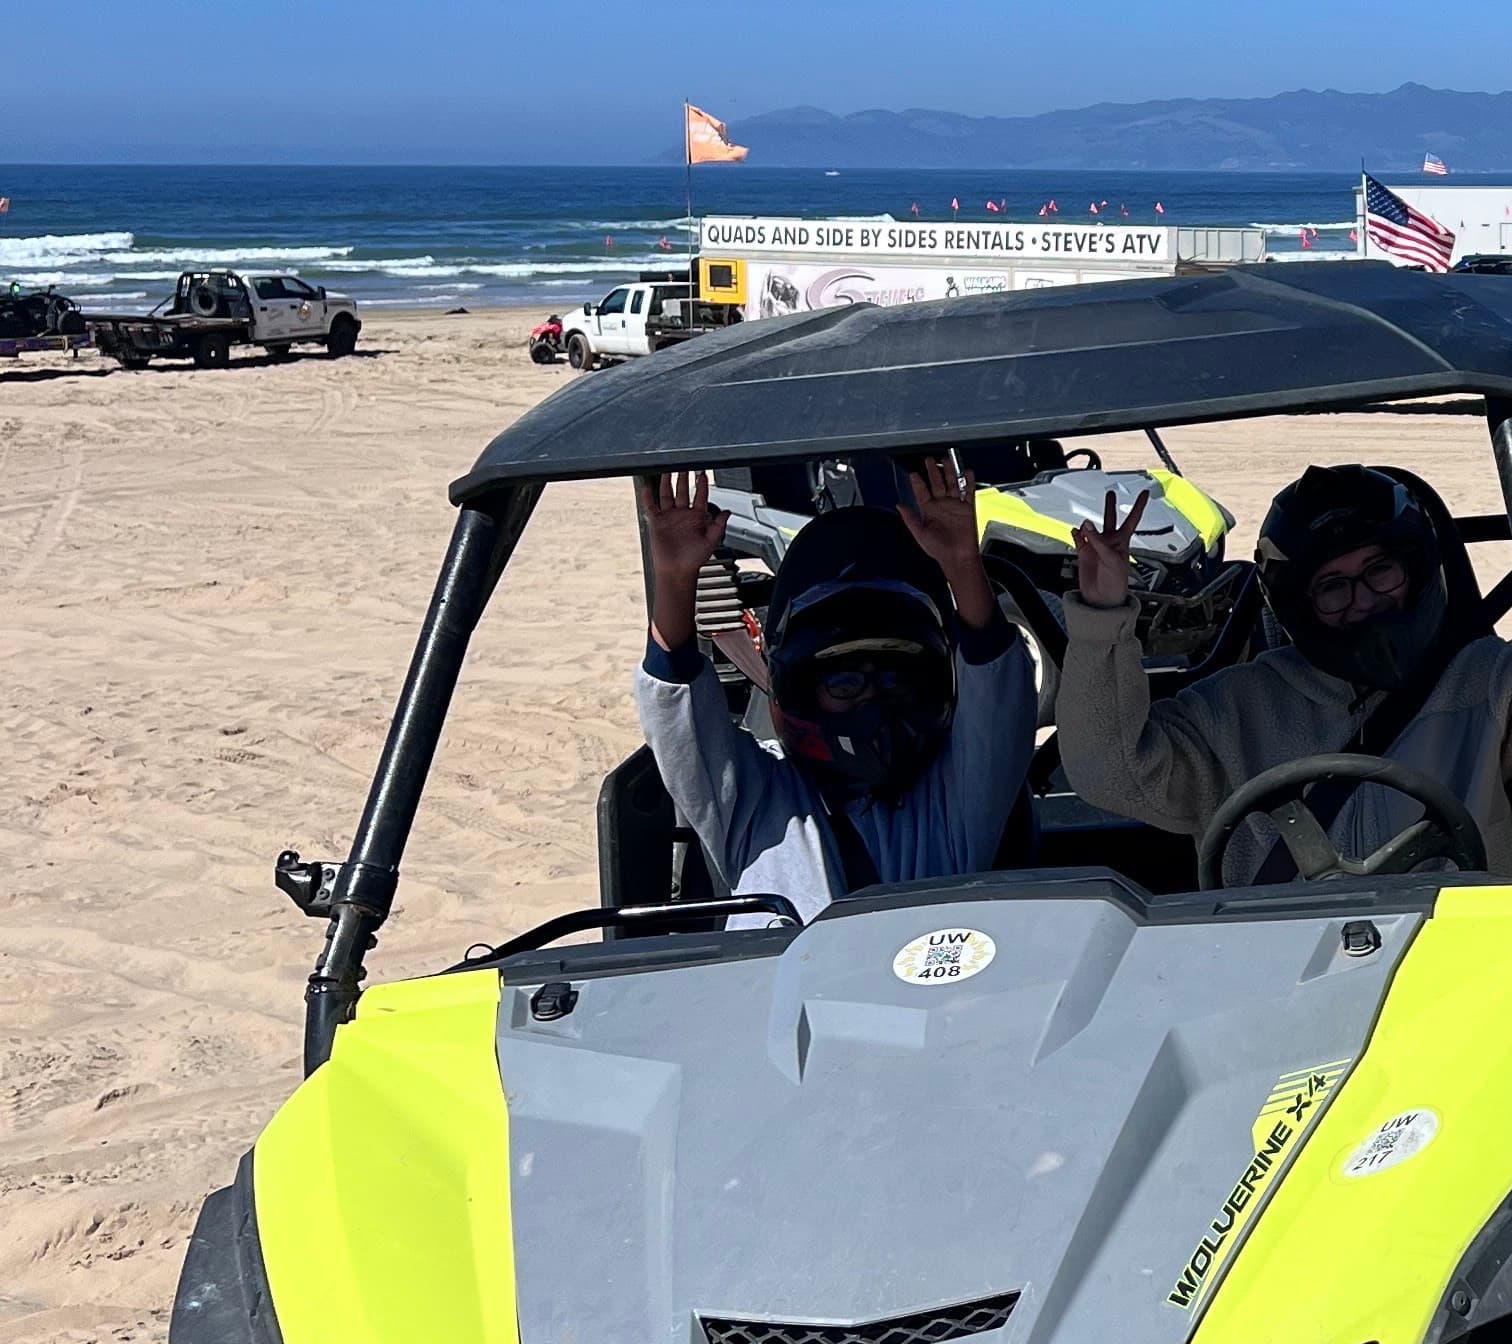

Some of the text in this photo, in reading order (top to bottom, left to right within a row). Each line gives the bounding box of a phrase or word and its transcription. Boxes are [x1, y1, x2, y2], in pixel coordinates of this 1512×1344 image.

[708, 224, 1162, 254] QUADS AND SIDE BY SIDES RENTALS STEVE'S ATV
[929, 932, 971, 946] UW
[918, 965, 961, 979] 408
[1381, 1113, 1419, 1133] UW
[1352, 1149, 1393, 1171] 217
[1168, 1120, 1294, 1308] WOLVERINE
